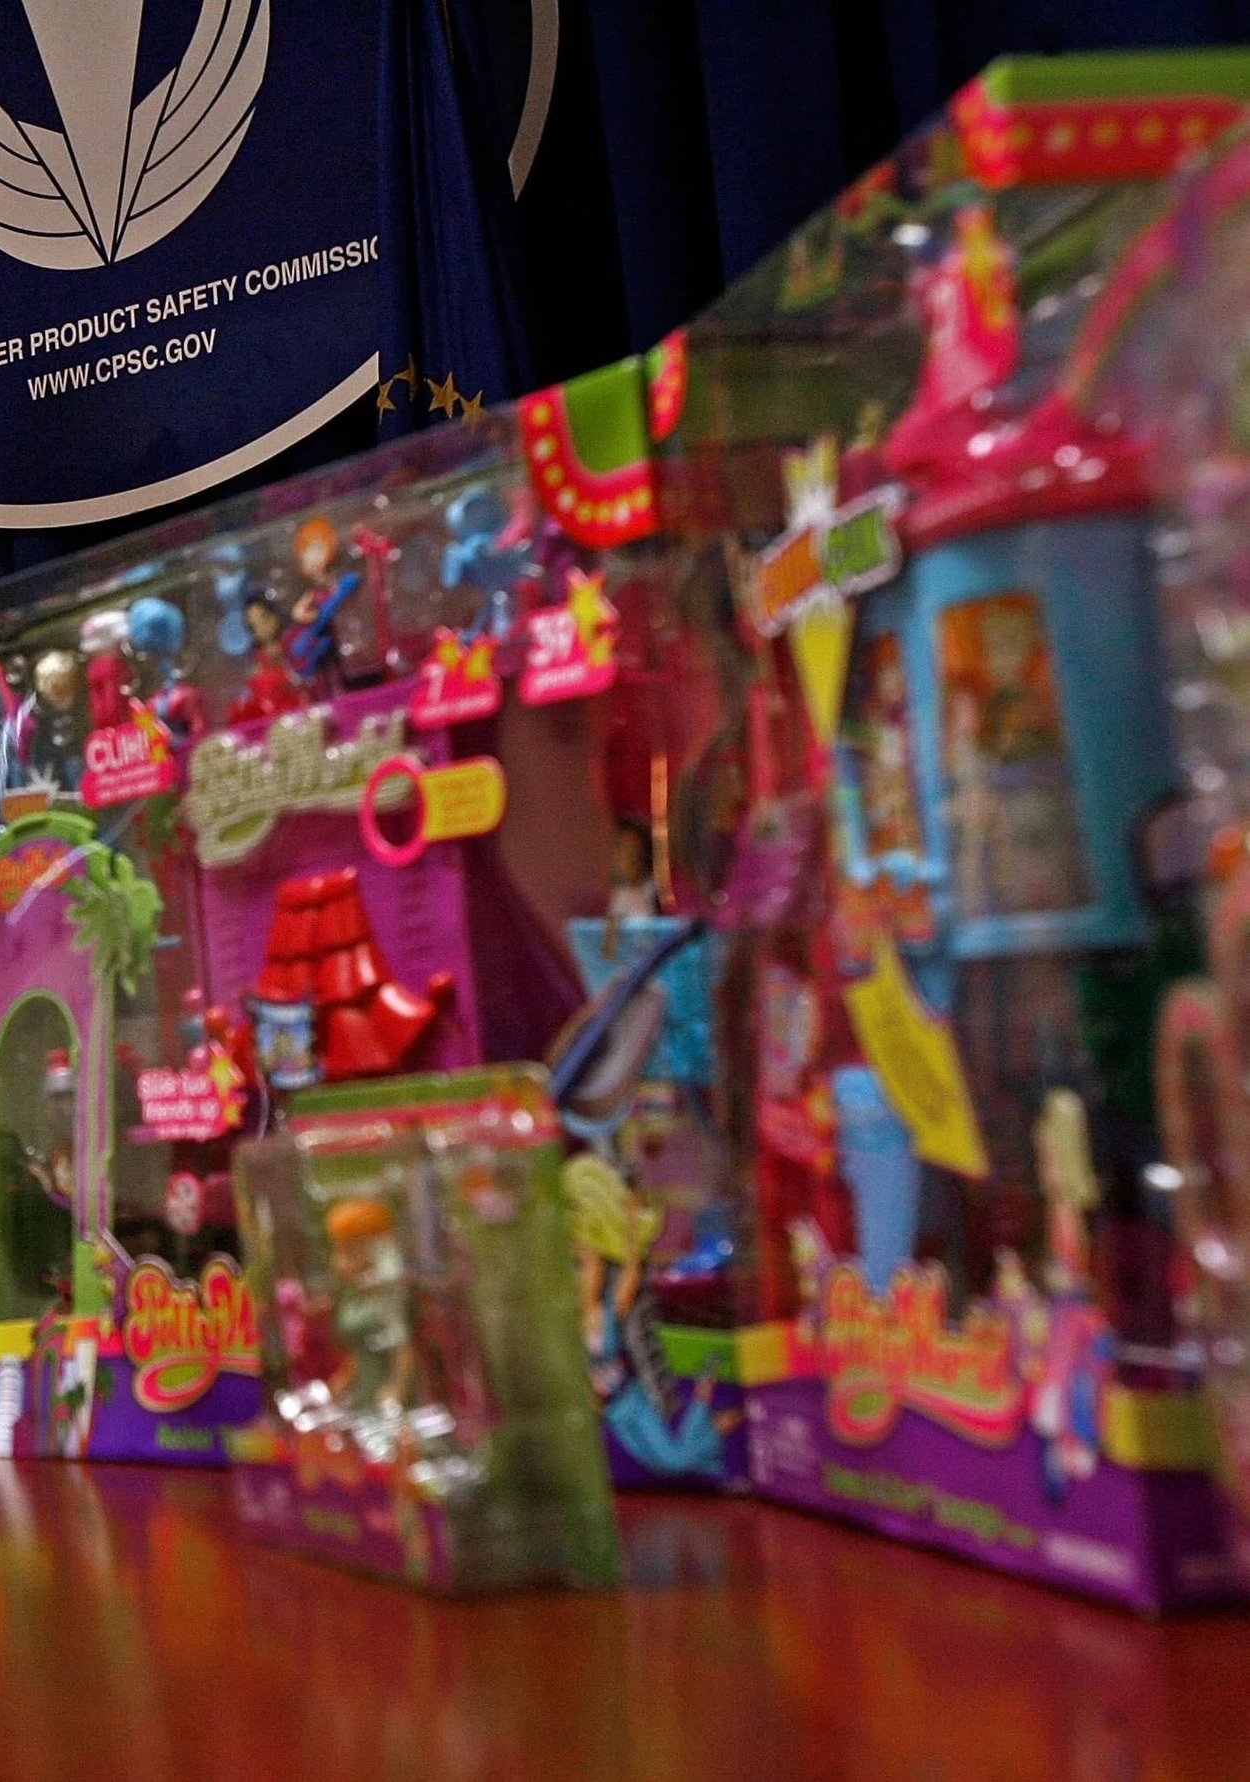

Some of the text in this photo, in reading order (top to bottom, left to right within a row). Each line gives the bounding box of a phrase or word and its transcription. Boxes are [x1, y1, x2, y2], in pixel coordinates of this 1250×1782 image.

[29, 303, 140, 357] PRODUCT
[146, 275, 238, 325] SAFETY
[27, 327, 217, 401] WWW.CPSC.GOV
